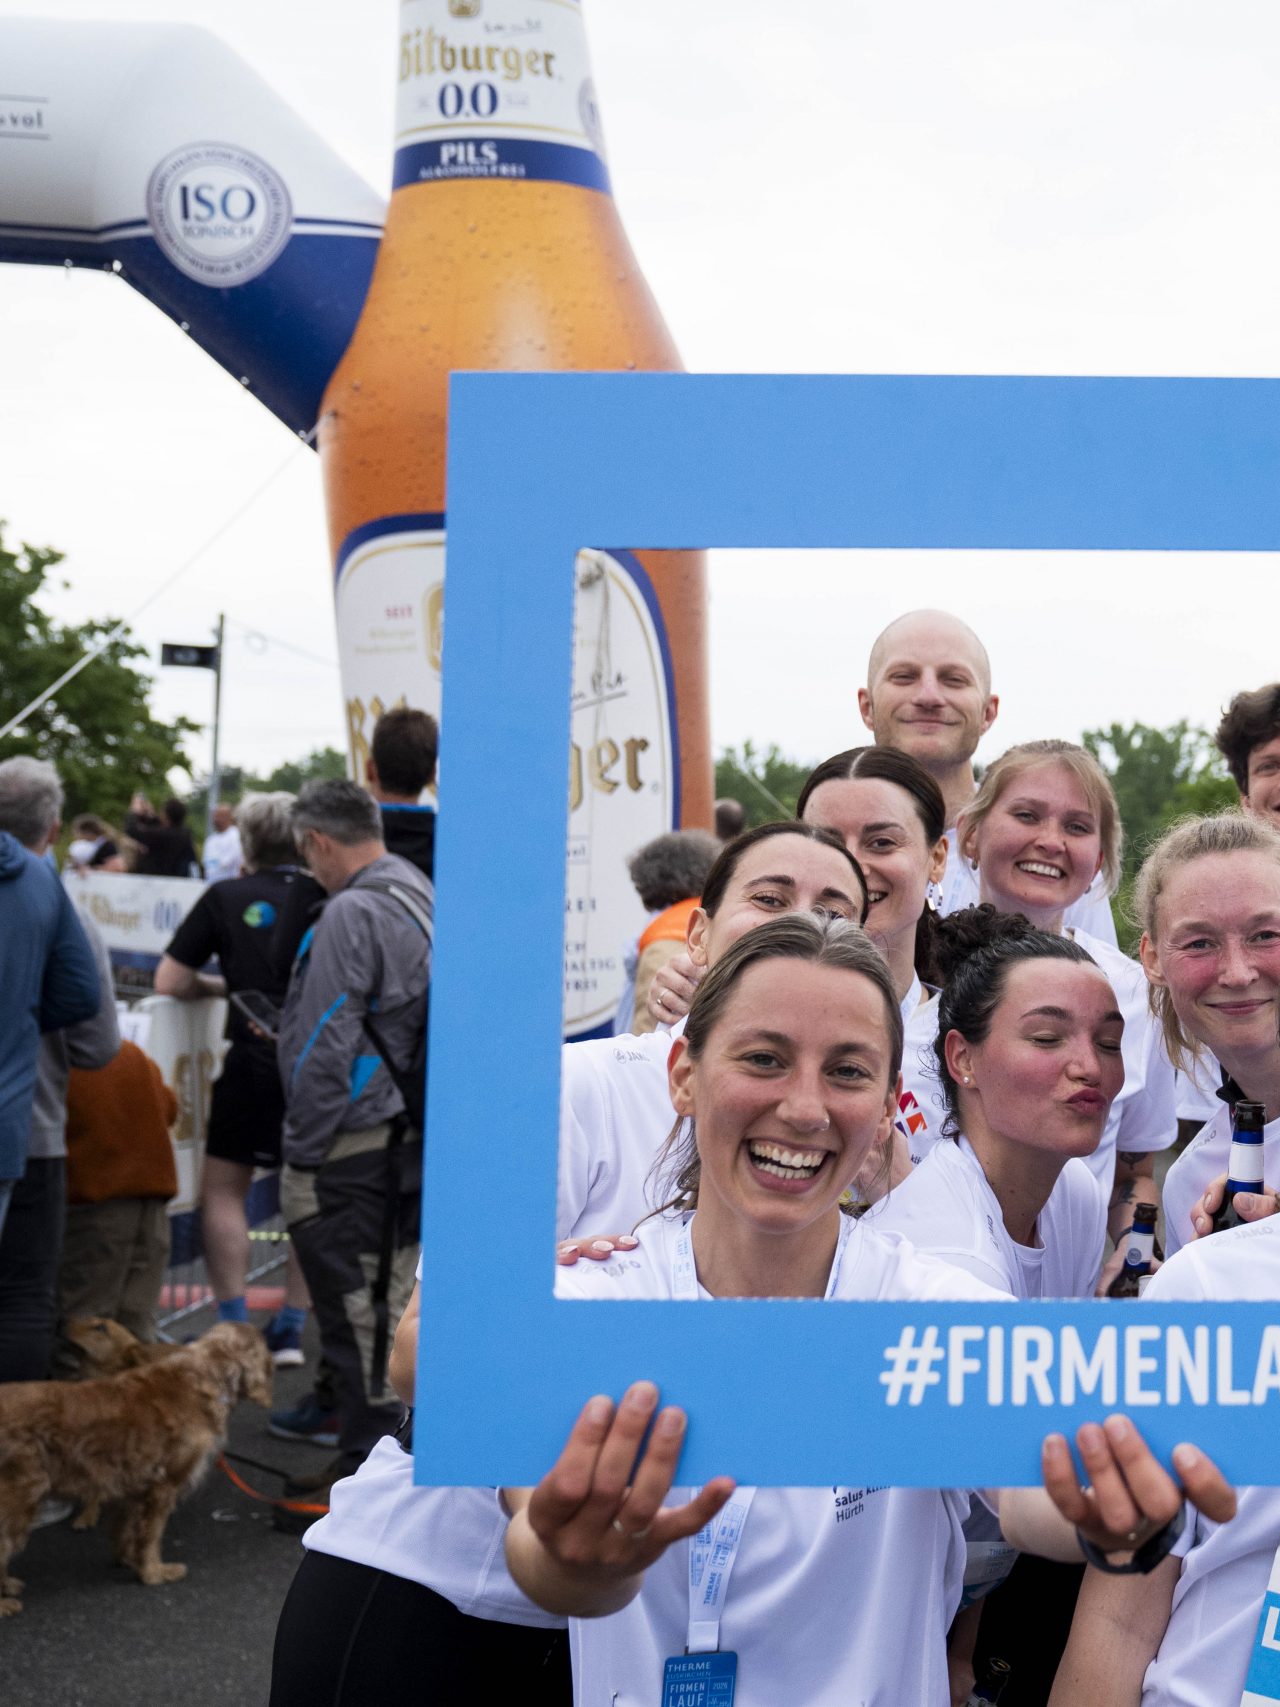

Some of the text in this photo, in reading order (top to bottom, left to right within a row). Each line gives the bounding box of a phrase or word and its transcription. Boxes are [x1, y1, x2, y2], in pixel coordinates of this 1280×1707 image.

[440, 142, 499, 166] PILS
[180, 183, 256, 222] ISO
[835, 1489, 864, 1507] salus
[836, 1501, 864, 1523] Hürth
[703, 1571, 717, 1605] THERME
[667, 1661, 712, 1673] THERME
[670, 1682, 705, 1695] FIRMEN
[669, 1693, 705, 1707] LAUF
